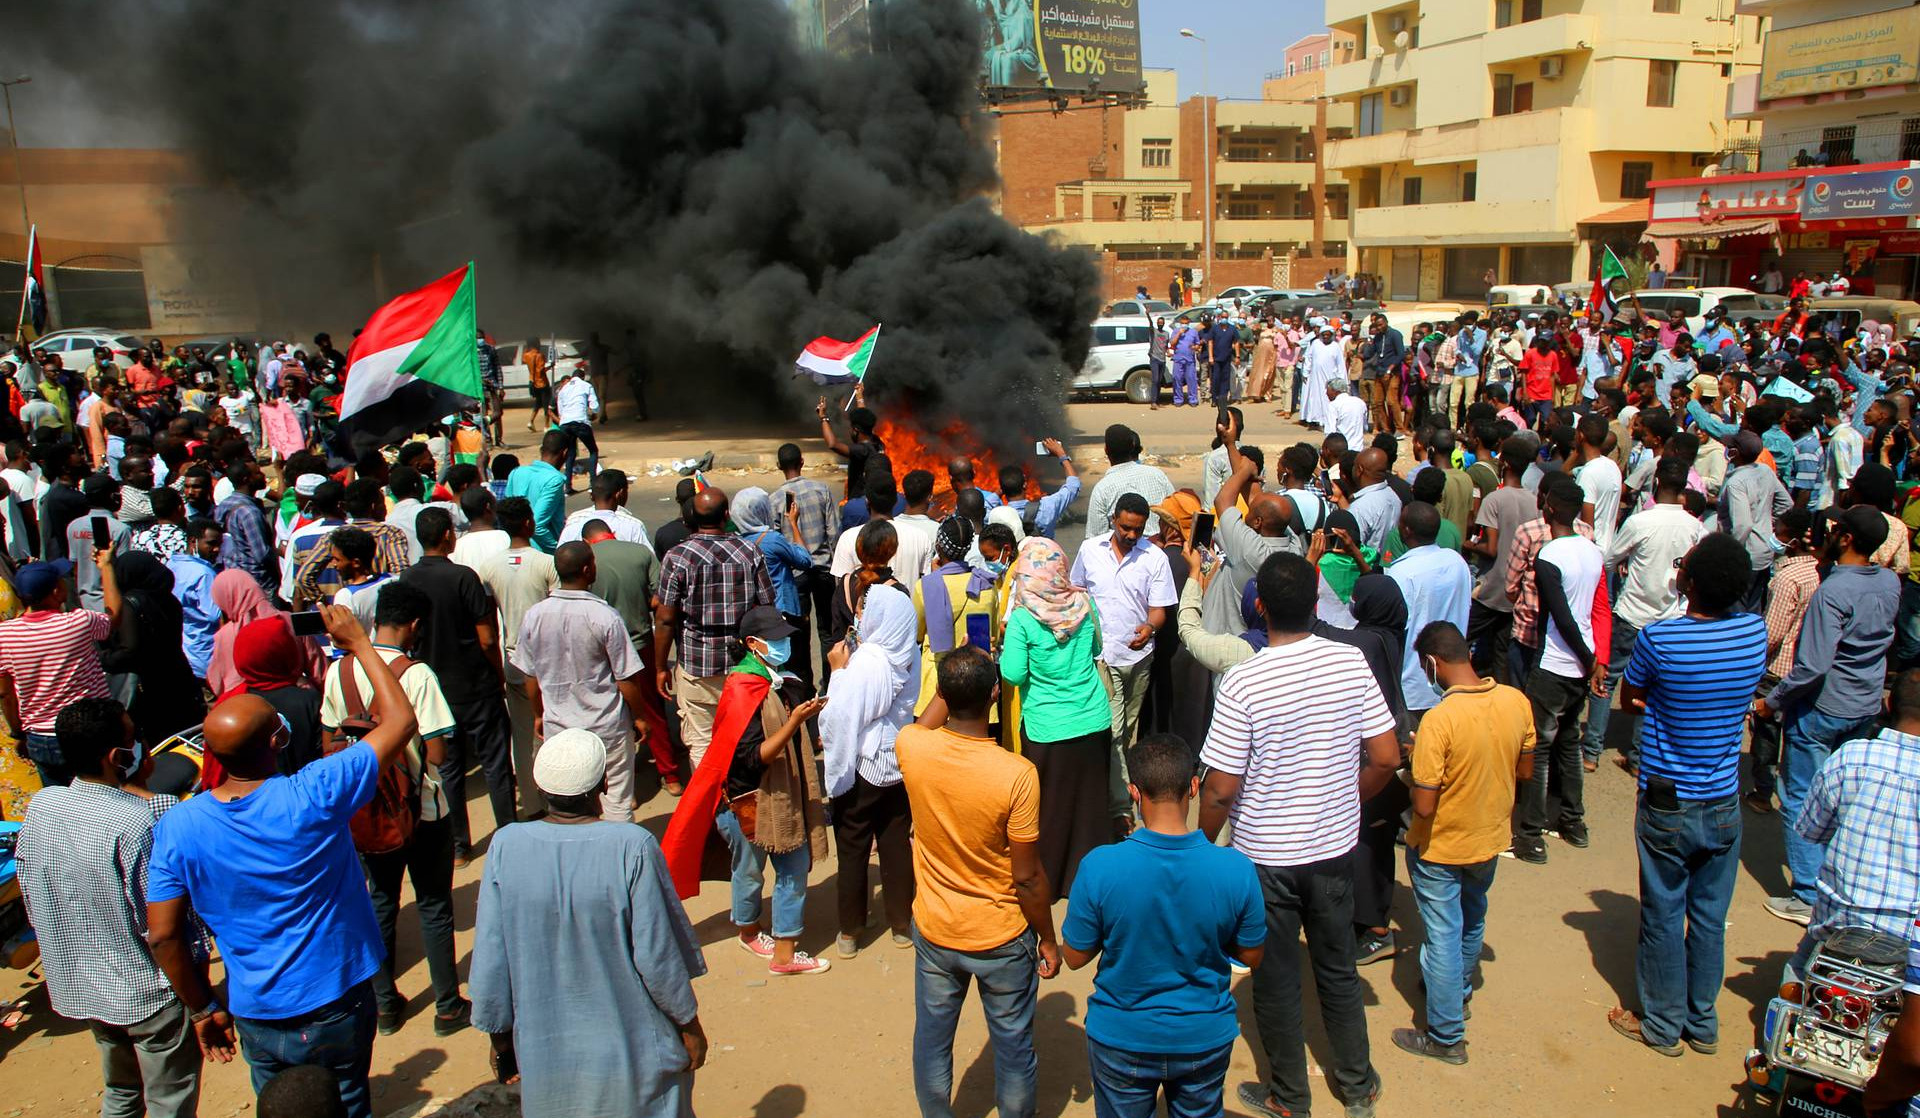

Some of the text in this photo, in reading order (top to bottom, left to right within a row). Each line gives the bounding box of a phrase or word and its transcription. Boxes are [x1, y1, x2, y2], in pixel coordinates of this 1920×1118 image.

[1040, 4, 1059, 24] أكبر
[1060, 9, 1079, 26] بنمو
[1101, 14, 1135, 30] مستقبل
[1863, 25, 1894, 41] المركز
[1061, 44, 1106, 75] 18%
[1808, 205, 1830, 214] pepsi
[1843, 198, 1876, 210] بست
[163, 300, 204, 310] ROYAL
[1787, 1096, 1852, 1118] JINCHE
